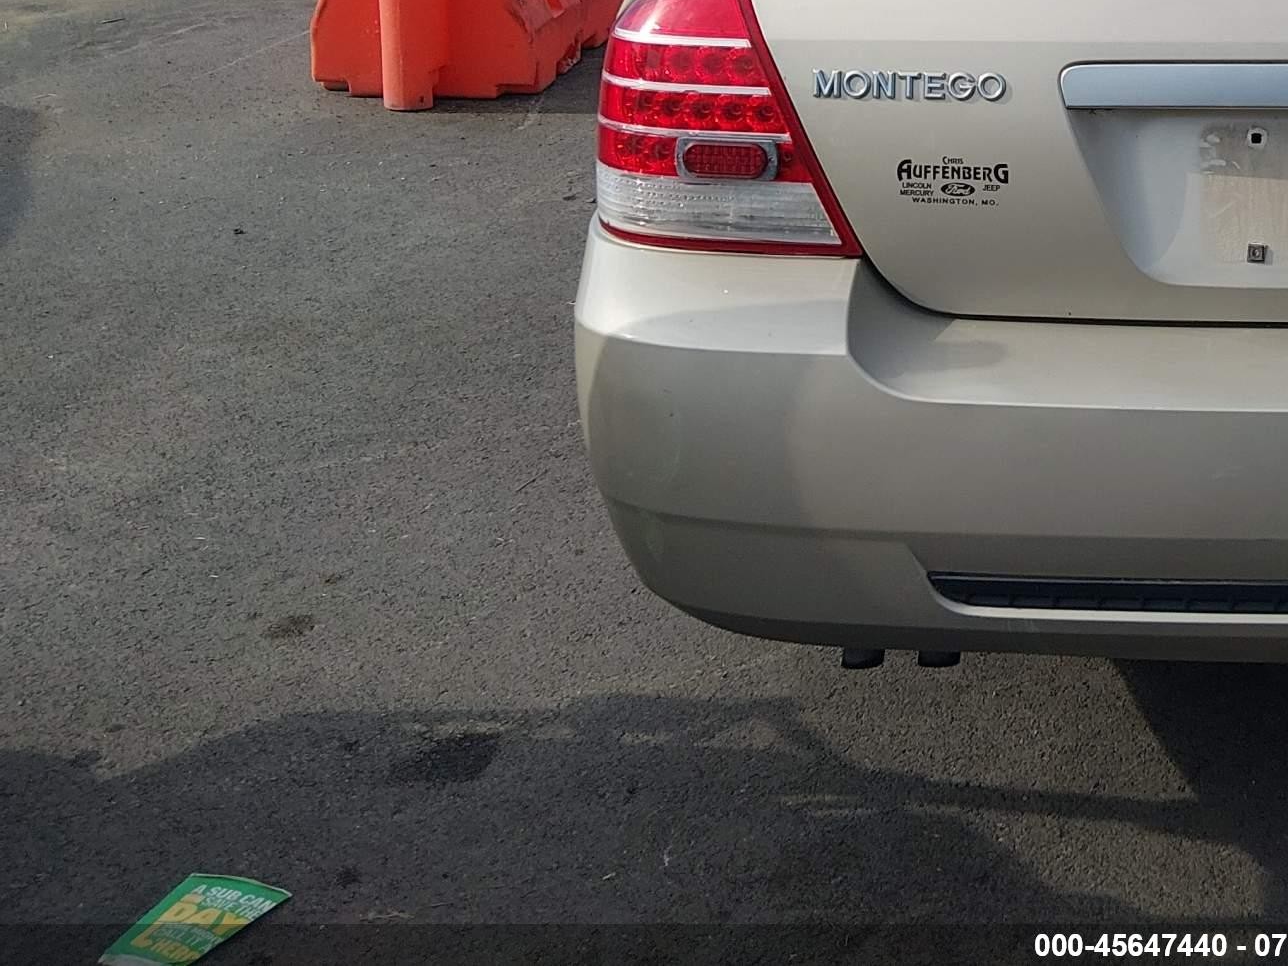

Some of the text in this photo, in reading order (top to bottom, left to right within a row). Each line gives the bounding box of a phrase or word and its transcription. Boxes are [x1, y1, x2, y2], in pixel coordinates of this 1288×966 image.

[813, 69, 1007, 101] MONTEGO
[897, 159, 1009, 184] AUFFENBERG
[900, 189, 934, 197] MERCURY
[982, 184, 1001, 192] JEEP
[912, 197, 978, 206] WASHINGTON,
[207, 886, 242, 901] SUB
[240, 894, 277, 915] CAN
[157, 901, 250, 937] DAY
